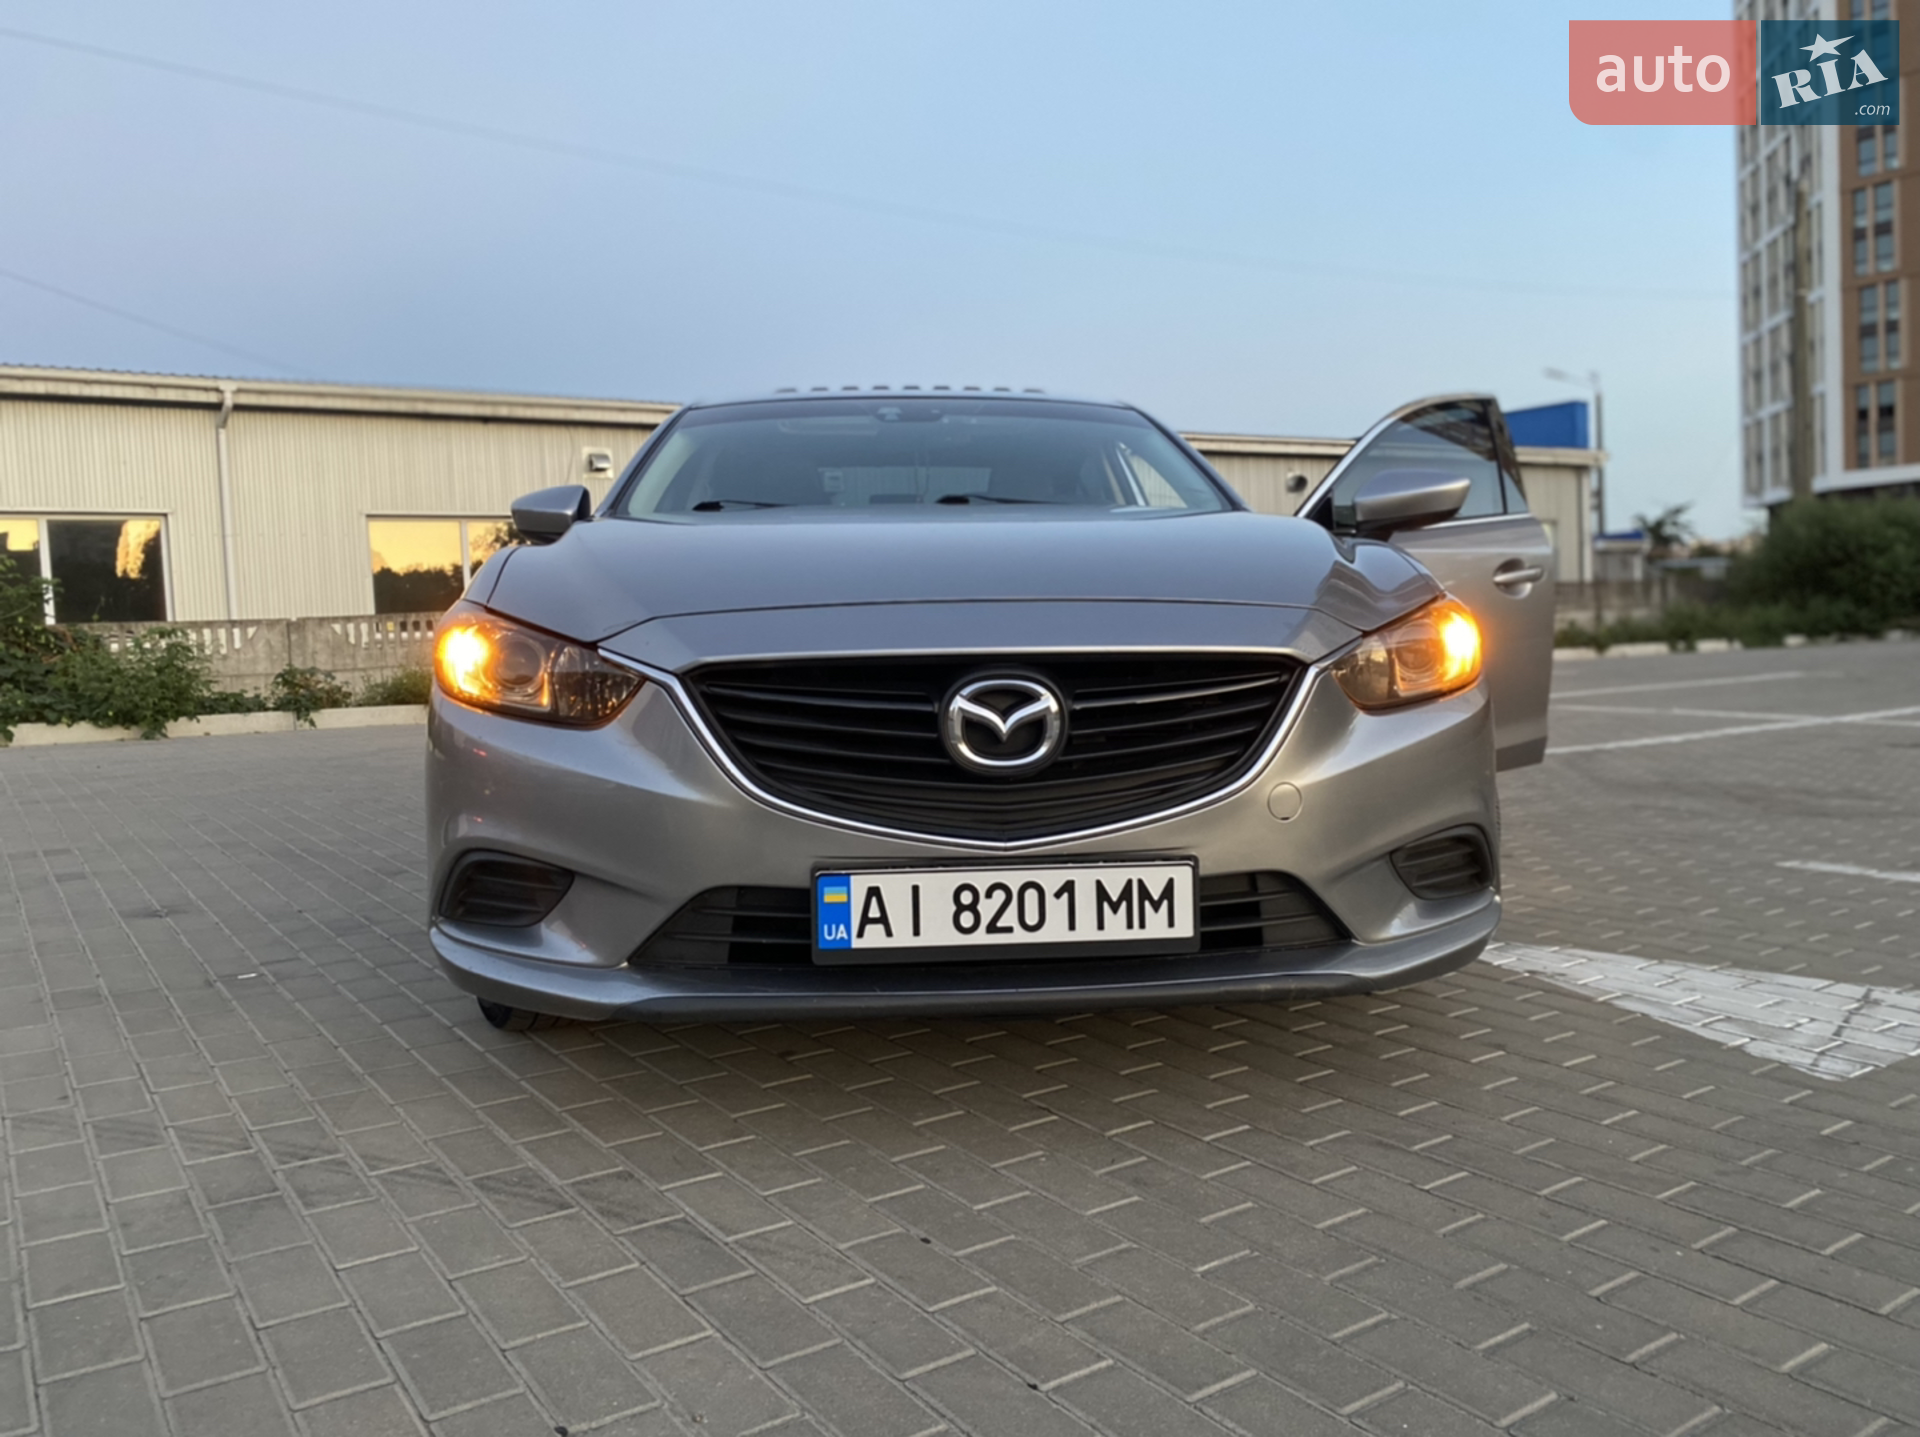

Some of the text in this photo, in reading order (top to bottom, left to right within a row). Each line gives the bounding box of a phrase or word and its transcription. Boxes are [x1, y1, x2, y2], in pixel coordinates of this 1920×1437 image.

[856, 877, 1175, 939] AI 8201 MM
[824, 924, 848, 940] UA
